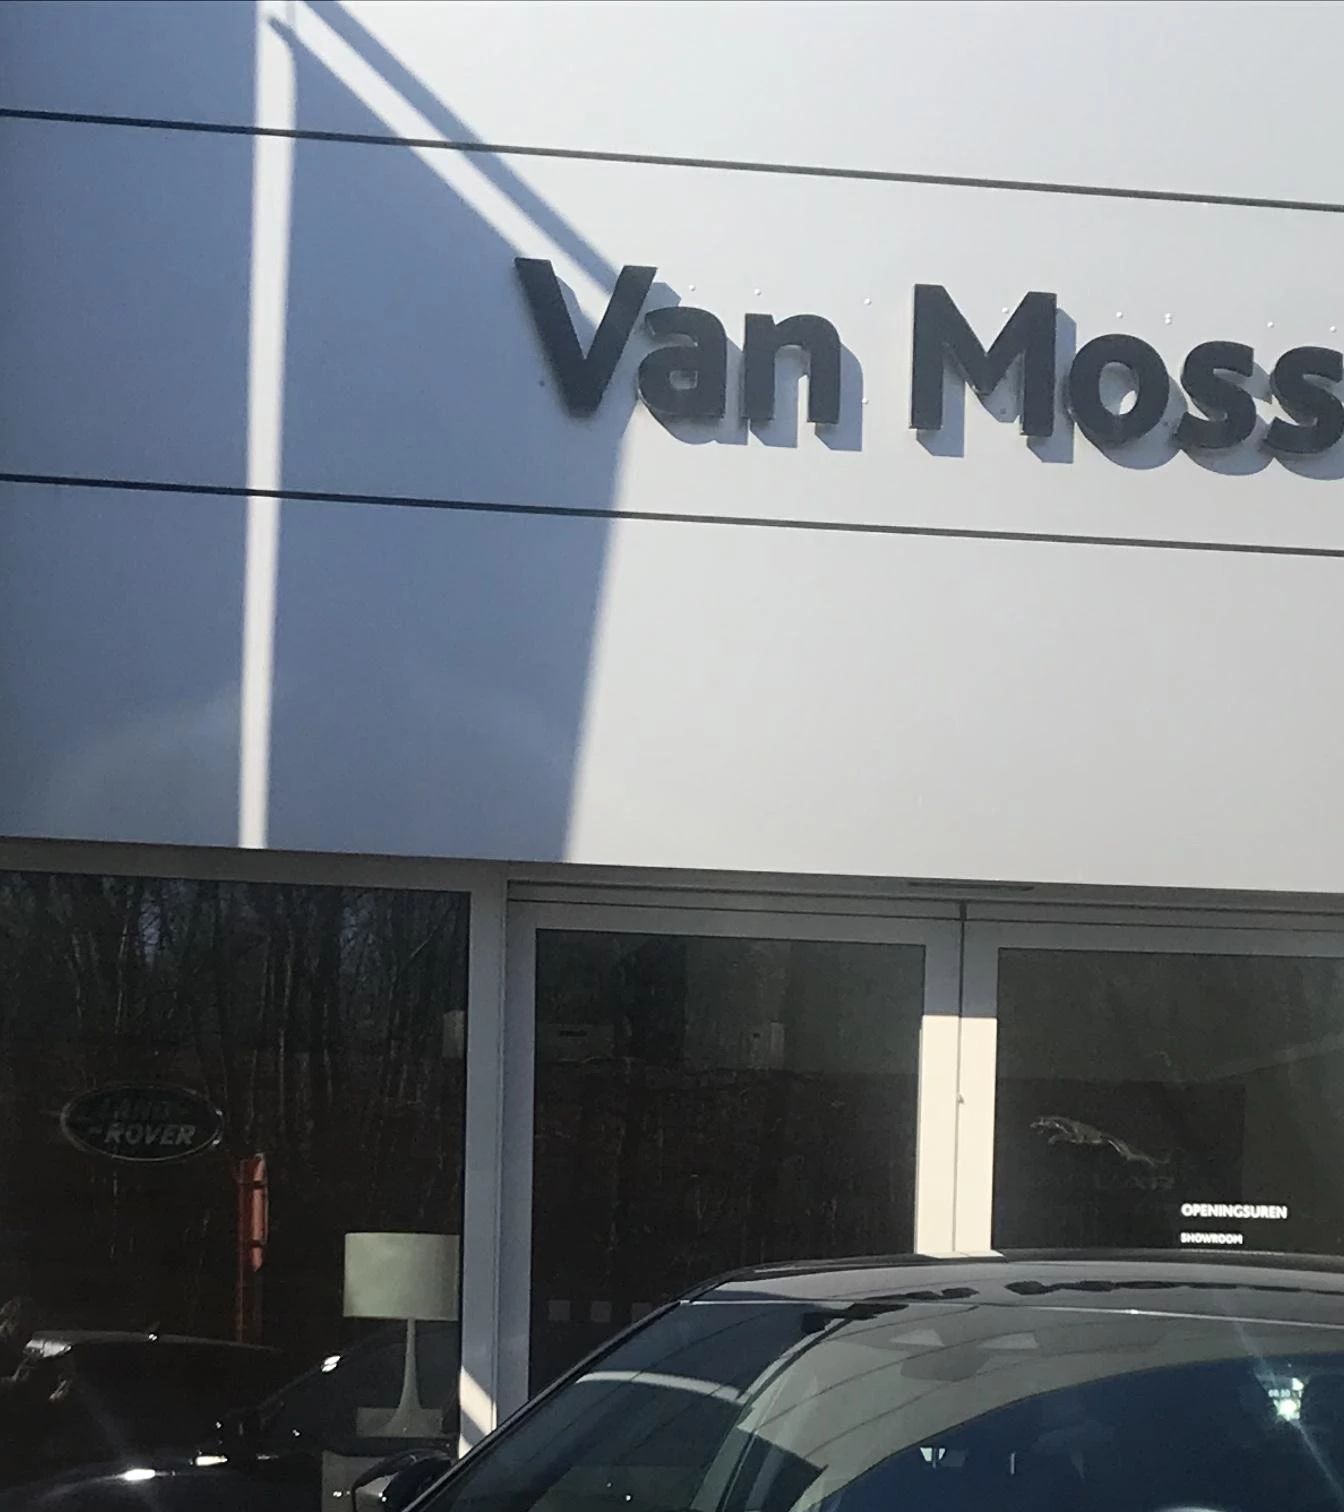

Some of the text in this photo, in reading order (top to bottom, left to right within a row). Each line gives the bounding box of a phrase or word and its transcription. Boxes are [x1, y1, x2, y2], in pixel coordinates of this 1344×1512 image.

[514, 256, 842, 425] Van
[103, 1122, 197, 1145] ROVER
[1180, 1203, 1288, 1220] OPENINGSUREN
[1180, 1231, 1244, 1245] SHOWROOM
